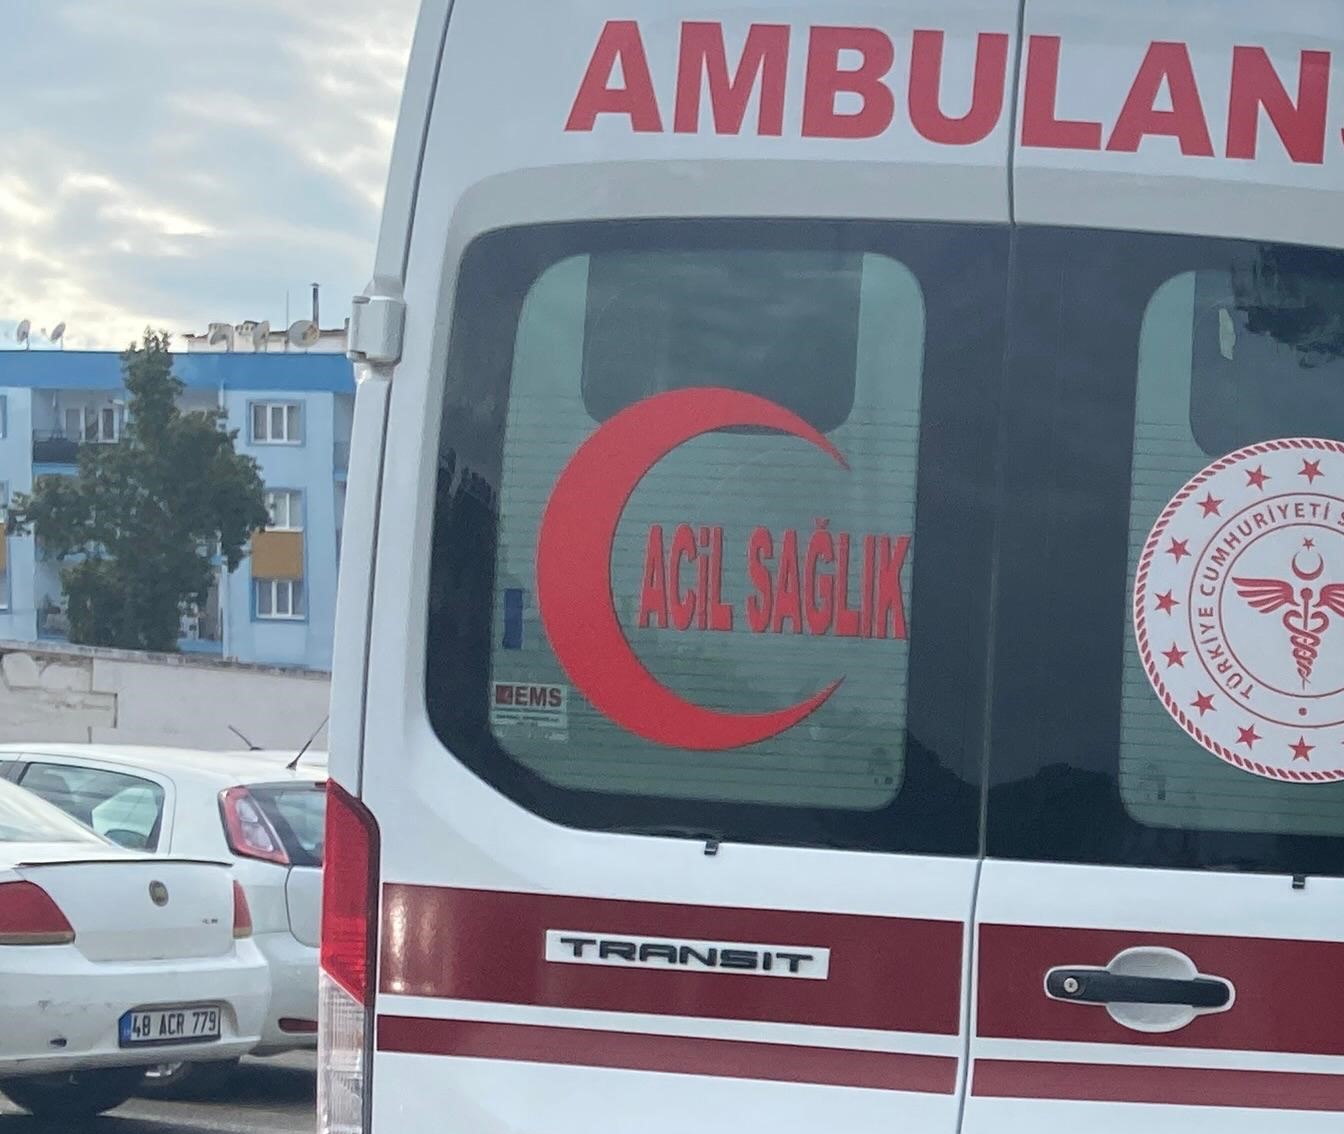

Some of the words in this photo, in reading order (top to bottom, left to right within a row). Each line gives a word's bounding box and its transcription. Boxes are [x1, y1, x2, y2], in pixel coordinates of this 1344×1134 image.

[638, 523, 733, 631] ACİL
[746, 517, 911, 640] SAĞLIK
[1200, 501, 1330, 597] CUMHURİYETİ
[1198, 606, 1254, 700] TÜRKİYE
[515, 686, 562, 707] EMS
[560, 937, 813, 973] TRANSIT
[132, 1013, 151, 1038] 48
[159, 1012, 185, 1037] ACR
[192, 1010, 217, 1034] 779
